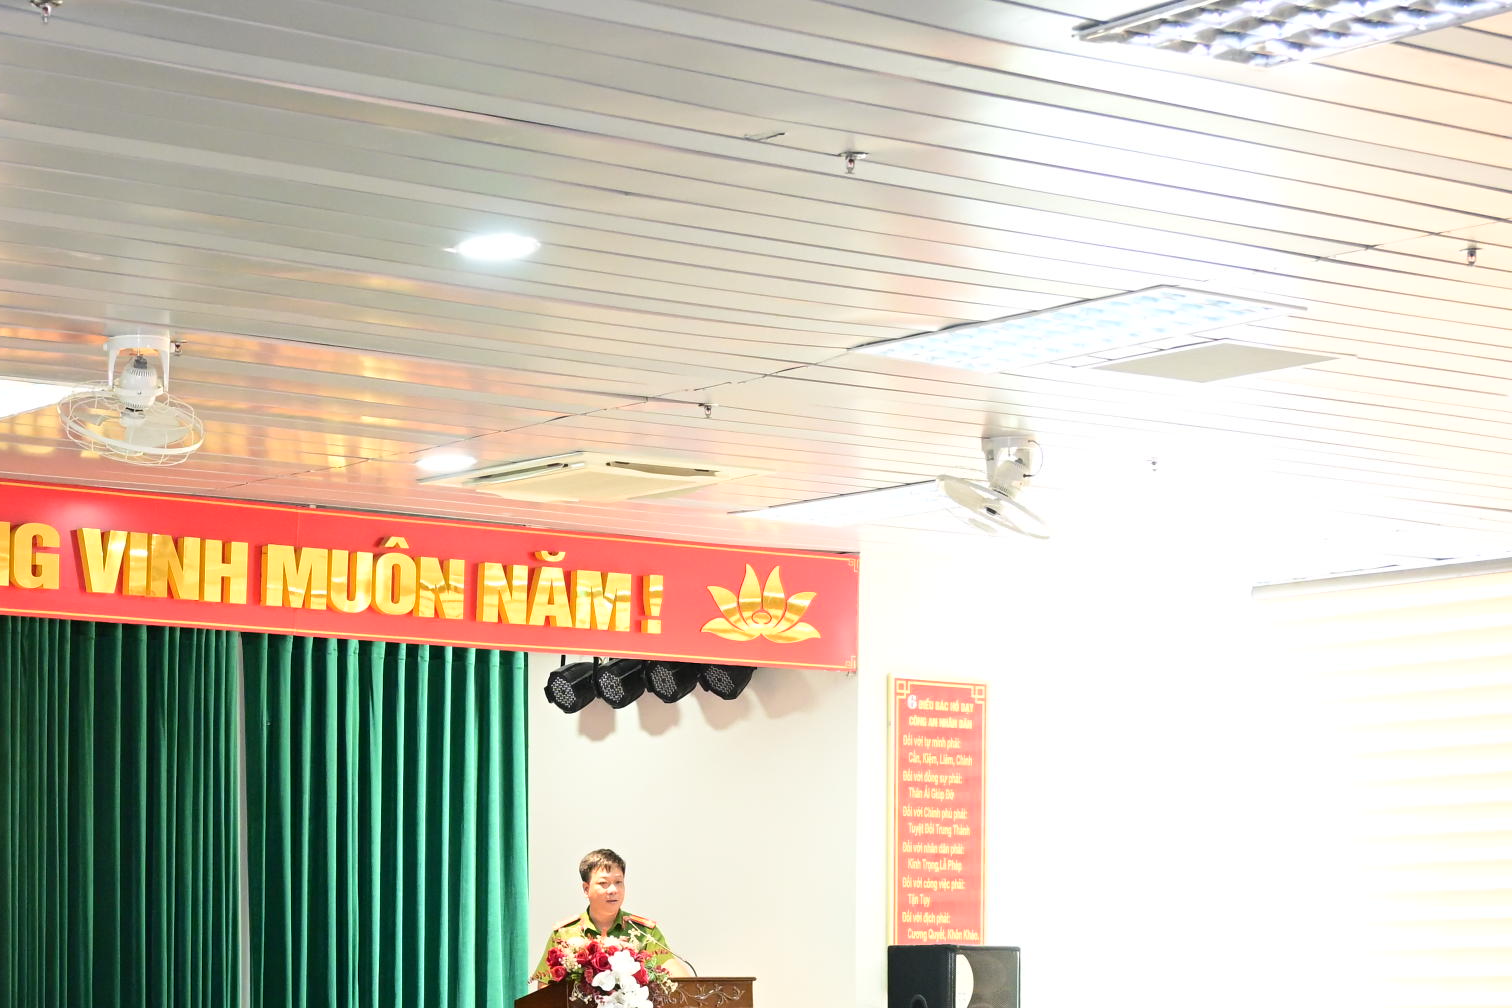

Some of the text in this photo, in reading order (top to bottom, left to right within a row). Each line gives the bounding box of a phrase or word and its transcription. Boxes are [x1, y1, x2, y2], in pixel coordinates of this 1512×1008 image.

[77, 527, 250, 605] VINH
[260, 535, 466, 620] MUÔN
[475, 551, 633, 633] NĂM
[908, 695, 917, 709] 6
[928, 718, 938, 727] AN
[936, 824, 951, 837] Trung
